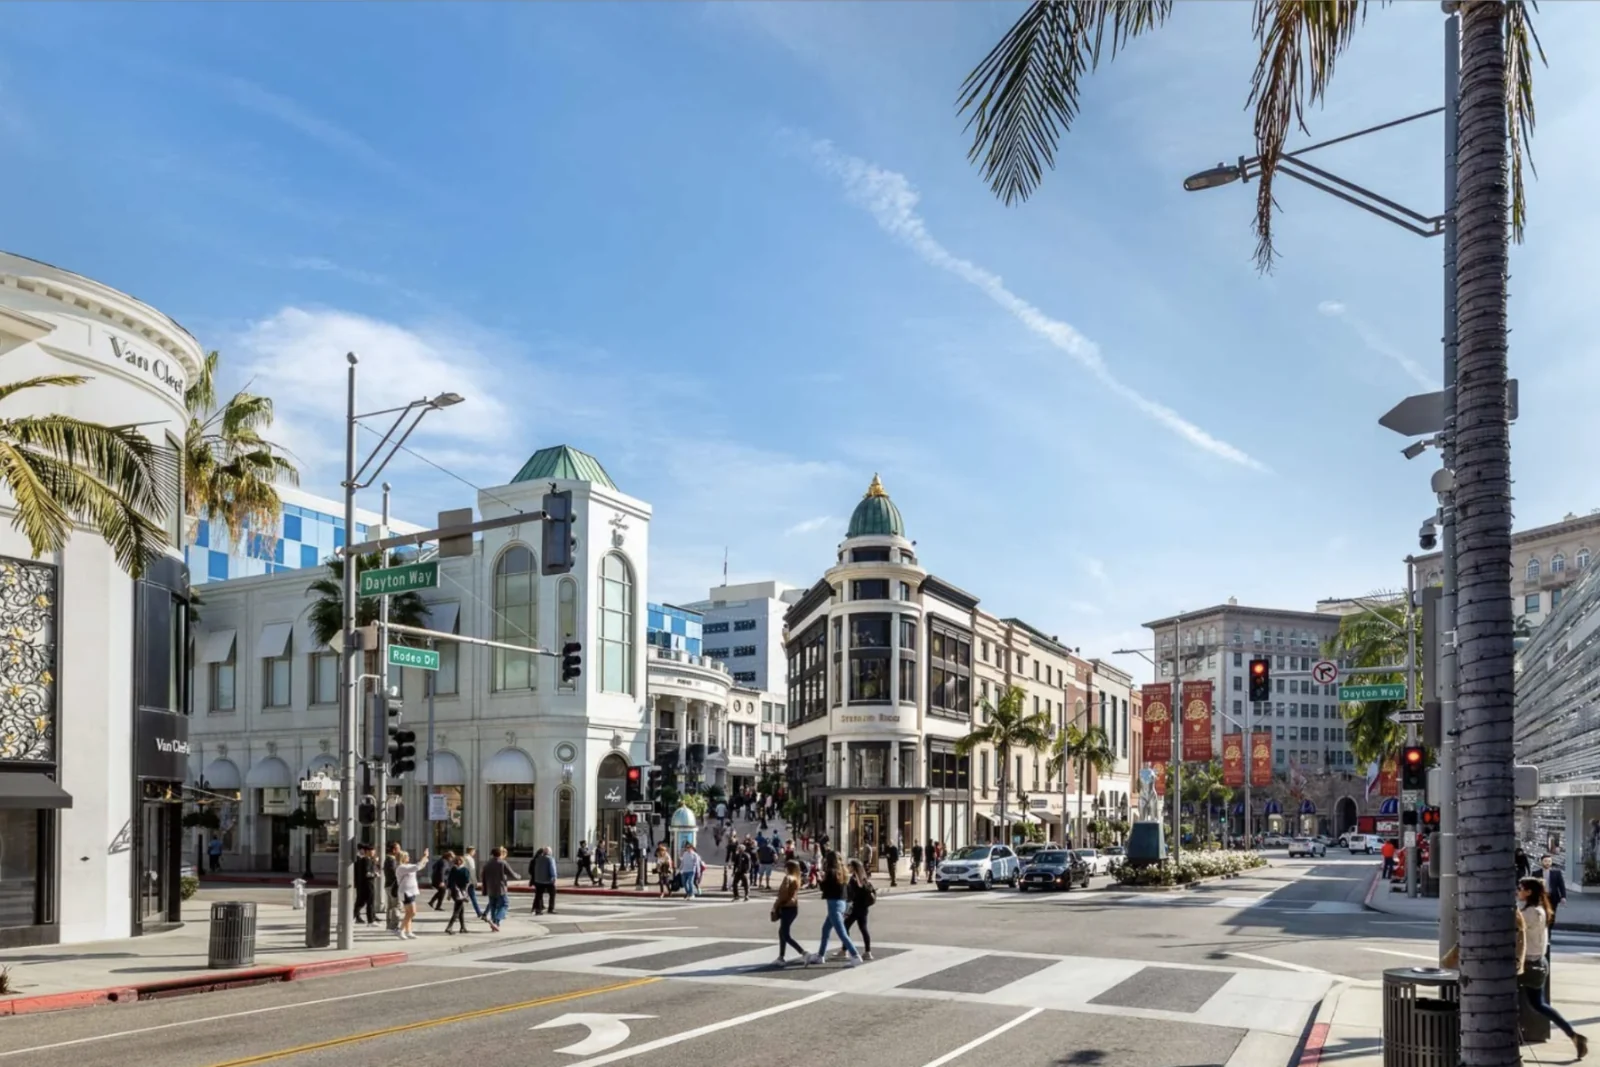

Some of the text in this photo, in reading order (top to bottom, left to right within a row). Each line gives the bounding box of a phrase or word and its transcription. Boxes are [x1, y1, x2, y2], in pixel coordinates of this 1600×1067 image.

[108, 336, 149, 372] Van
[365, 569, 432, 592] Dayton Way
[393, 650, 435, 665] Rodeo Dr
[1342, 688, 1401, 699] Dayton Way
[156, 738, 172, 752] Van
